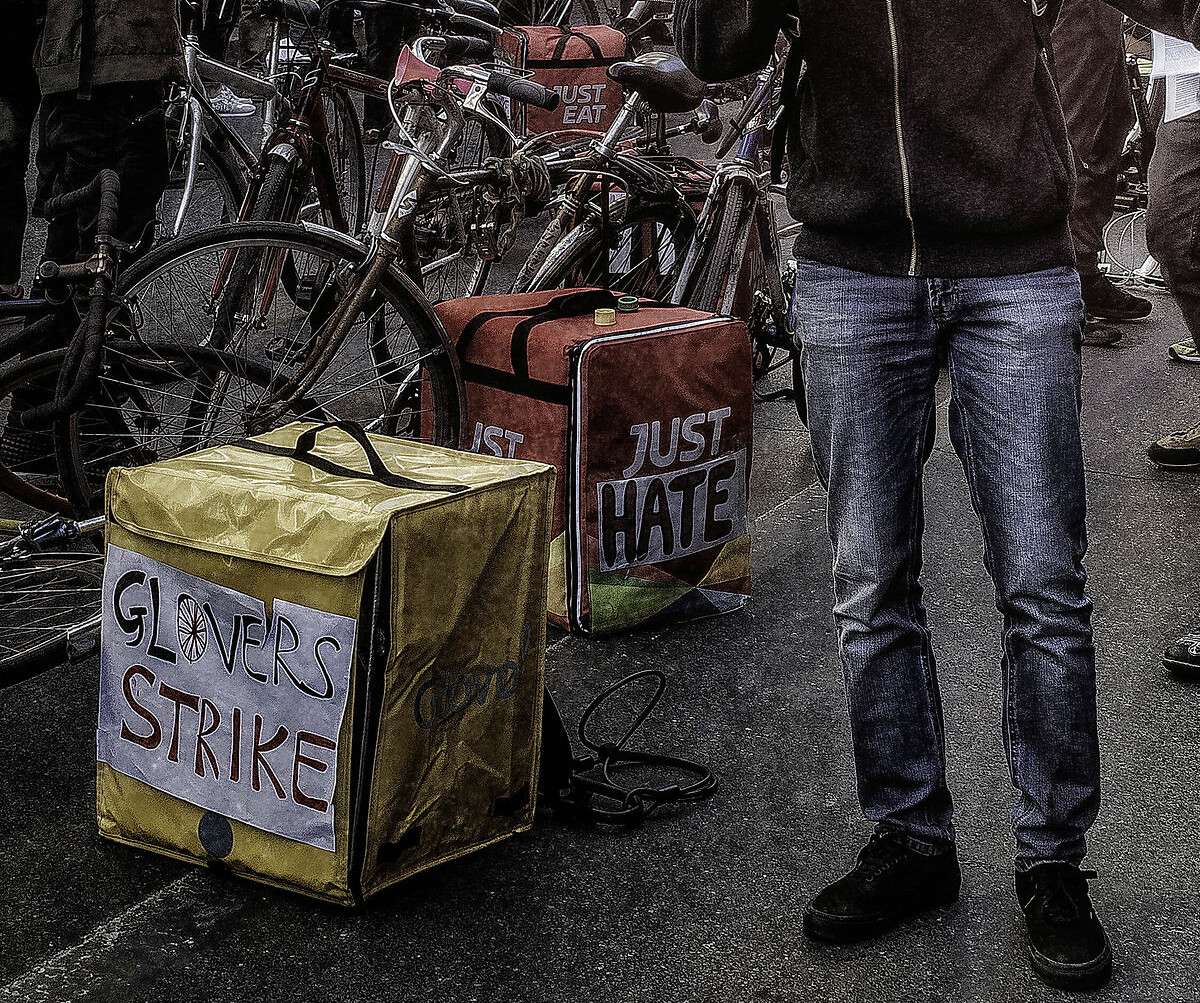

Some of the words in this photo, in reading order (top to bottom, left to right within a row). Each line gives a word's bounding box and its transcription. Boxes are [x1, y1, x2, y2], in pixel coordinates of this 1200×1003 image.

[562, 104, 607, 124] EAT
[622, 406, 732, 479] JUST
[601, 458, 737, 568] HATE
[112, 569, 341, 700] GLOVERS
[120, 664, 338, 814] STRIKE
